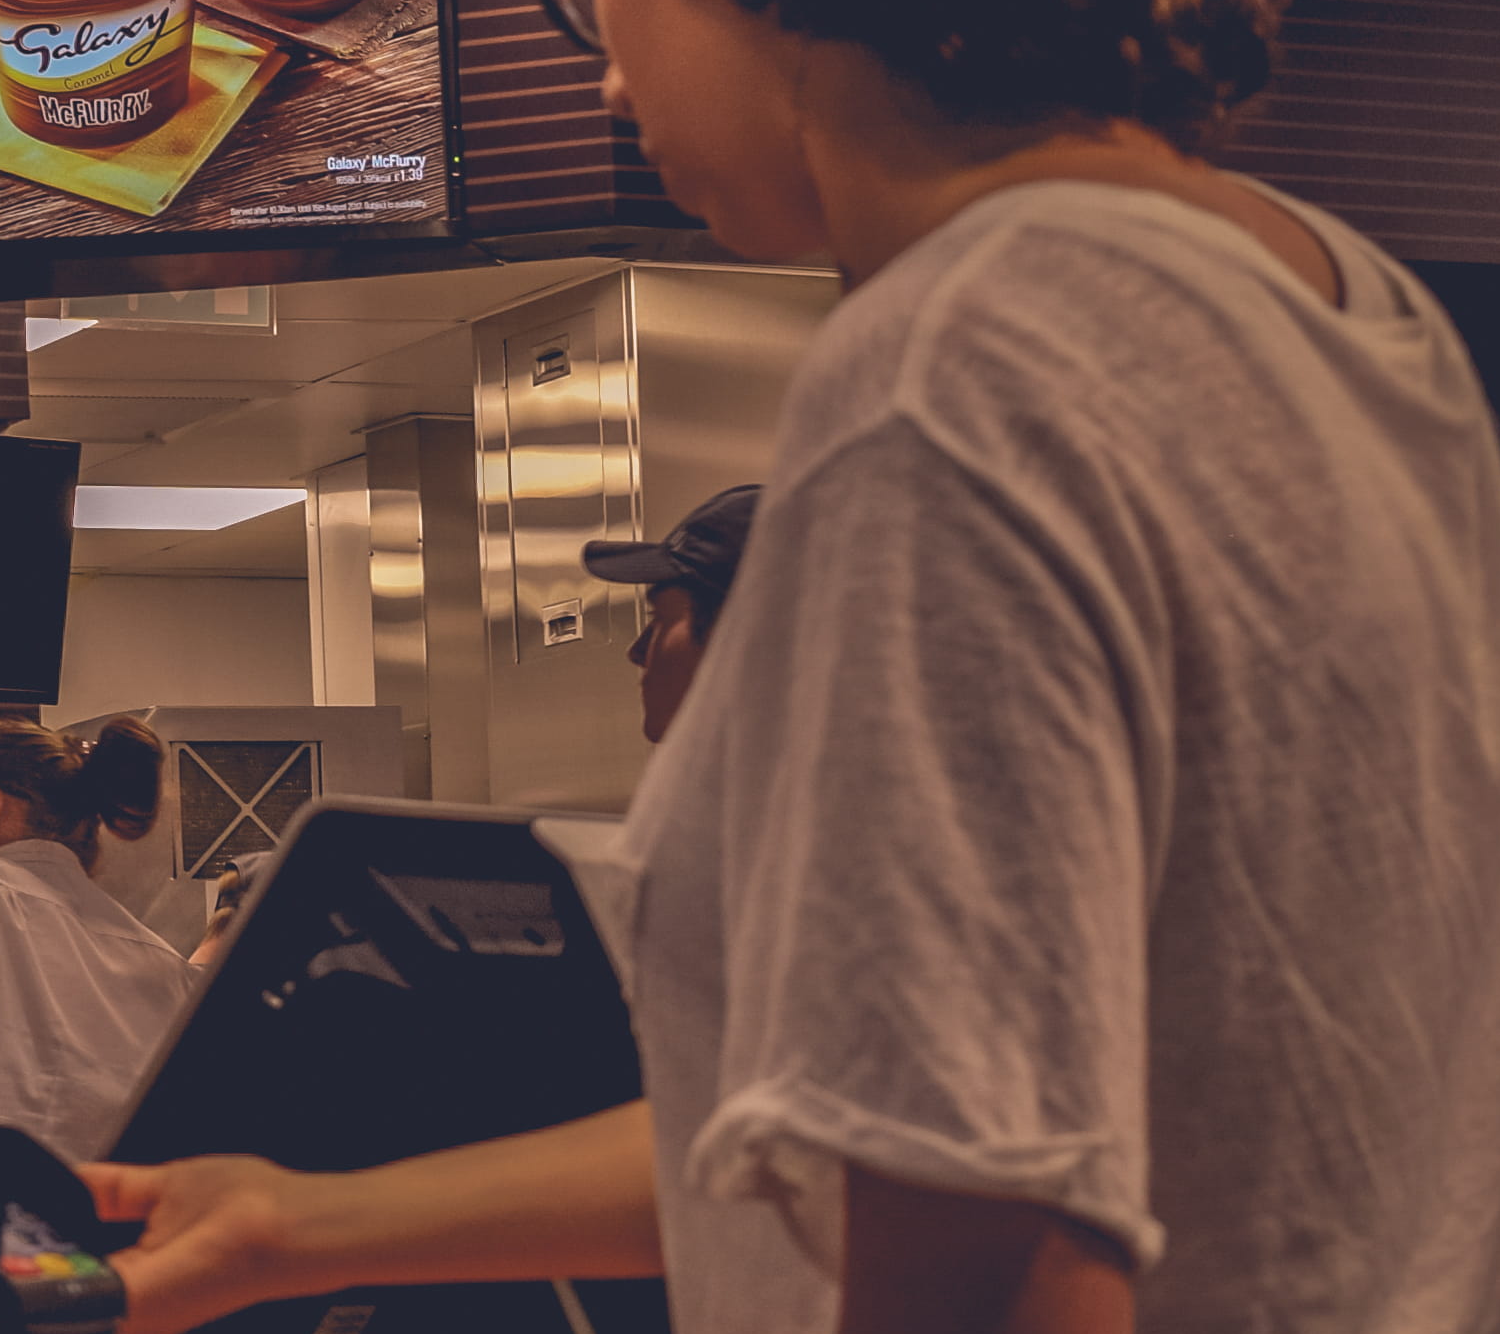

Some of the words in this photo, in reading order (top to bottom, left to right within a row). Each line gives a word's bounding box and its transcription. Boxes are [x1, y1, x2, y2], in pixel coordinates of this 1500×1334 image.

[63, 63, 117, 91] Caramel
[326, 156, 367, 171] Galaxy
[371, 153, 426, 169] McFlurry
